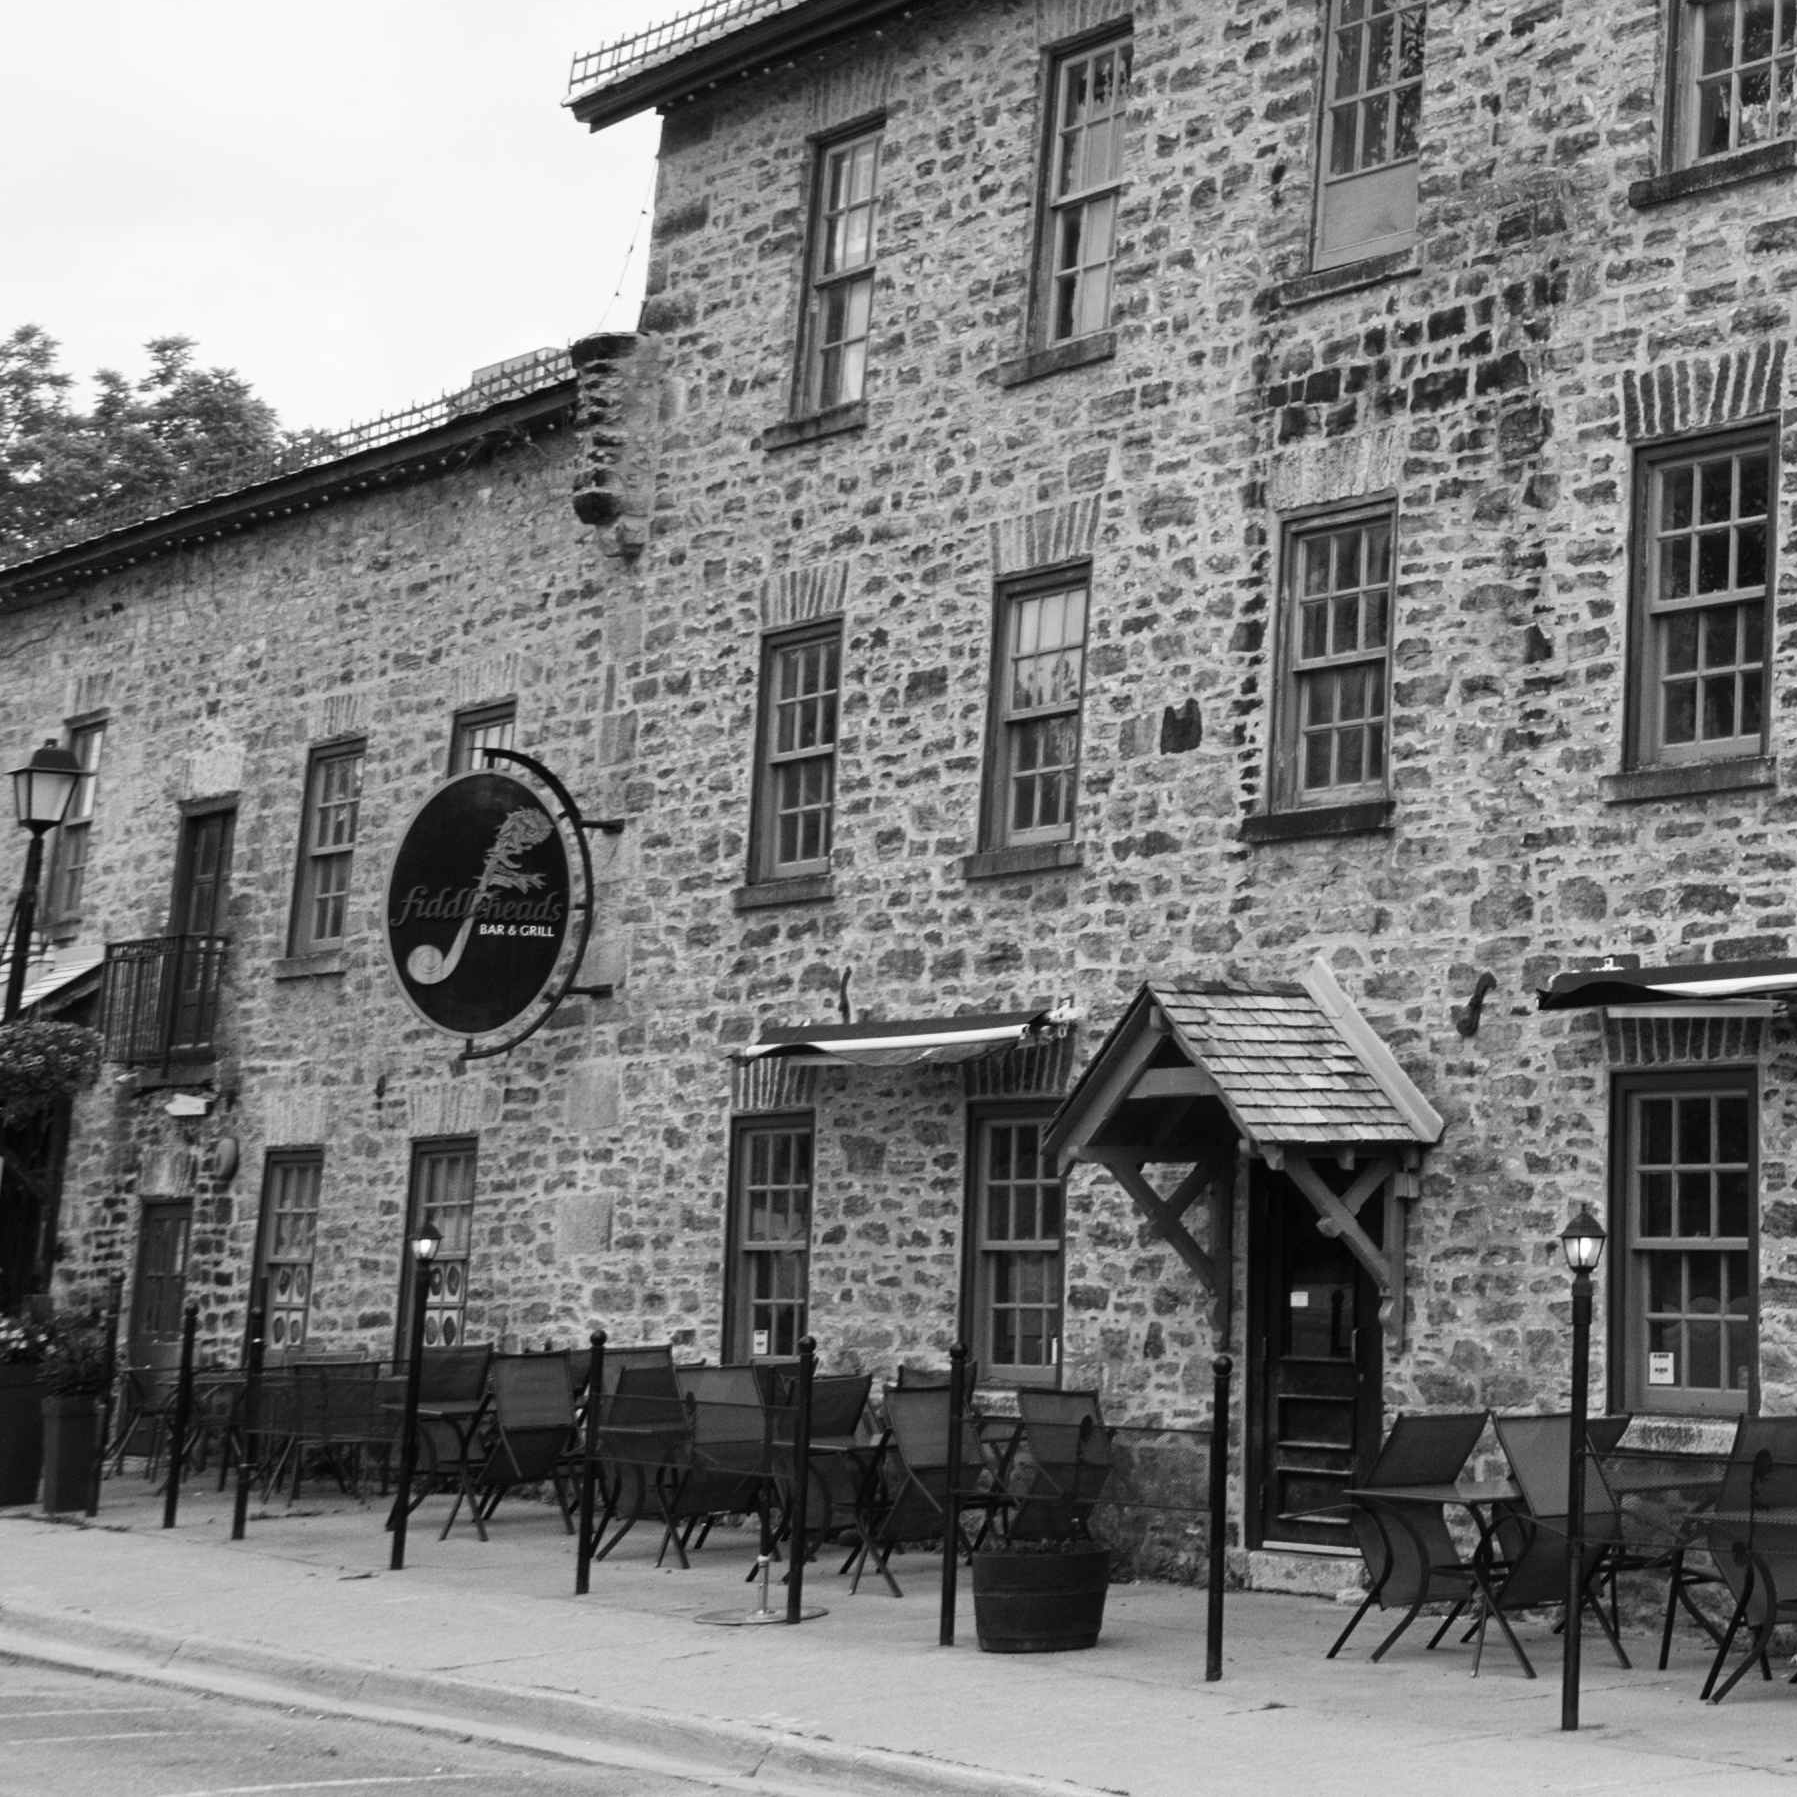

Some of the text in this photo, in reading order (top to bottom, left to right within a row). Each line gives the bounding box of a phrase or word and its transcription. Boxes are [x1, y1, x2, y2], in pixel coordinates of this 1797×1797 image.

[478, 923, 555, 938] BAR & GRILL
